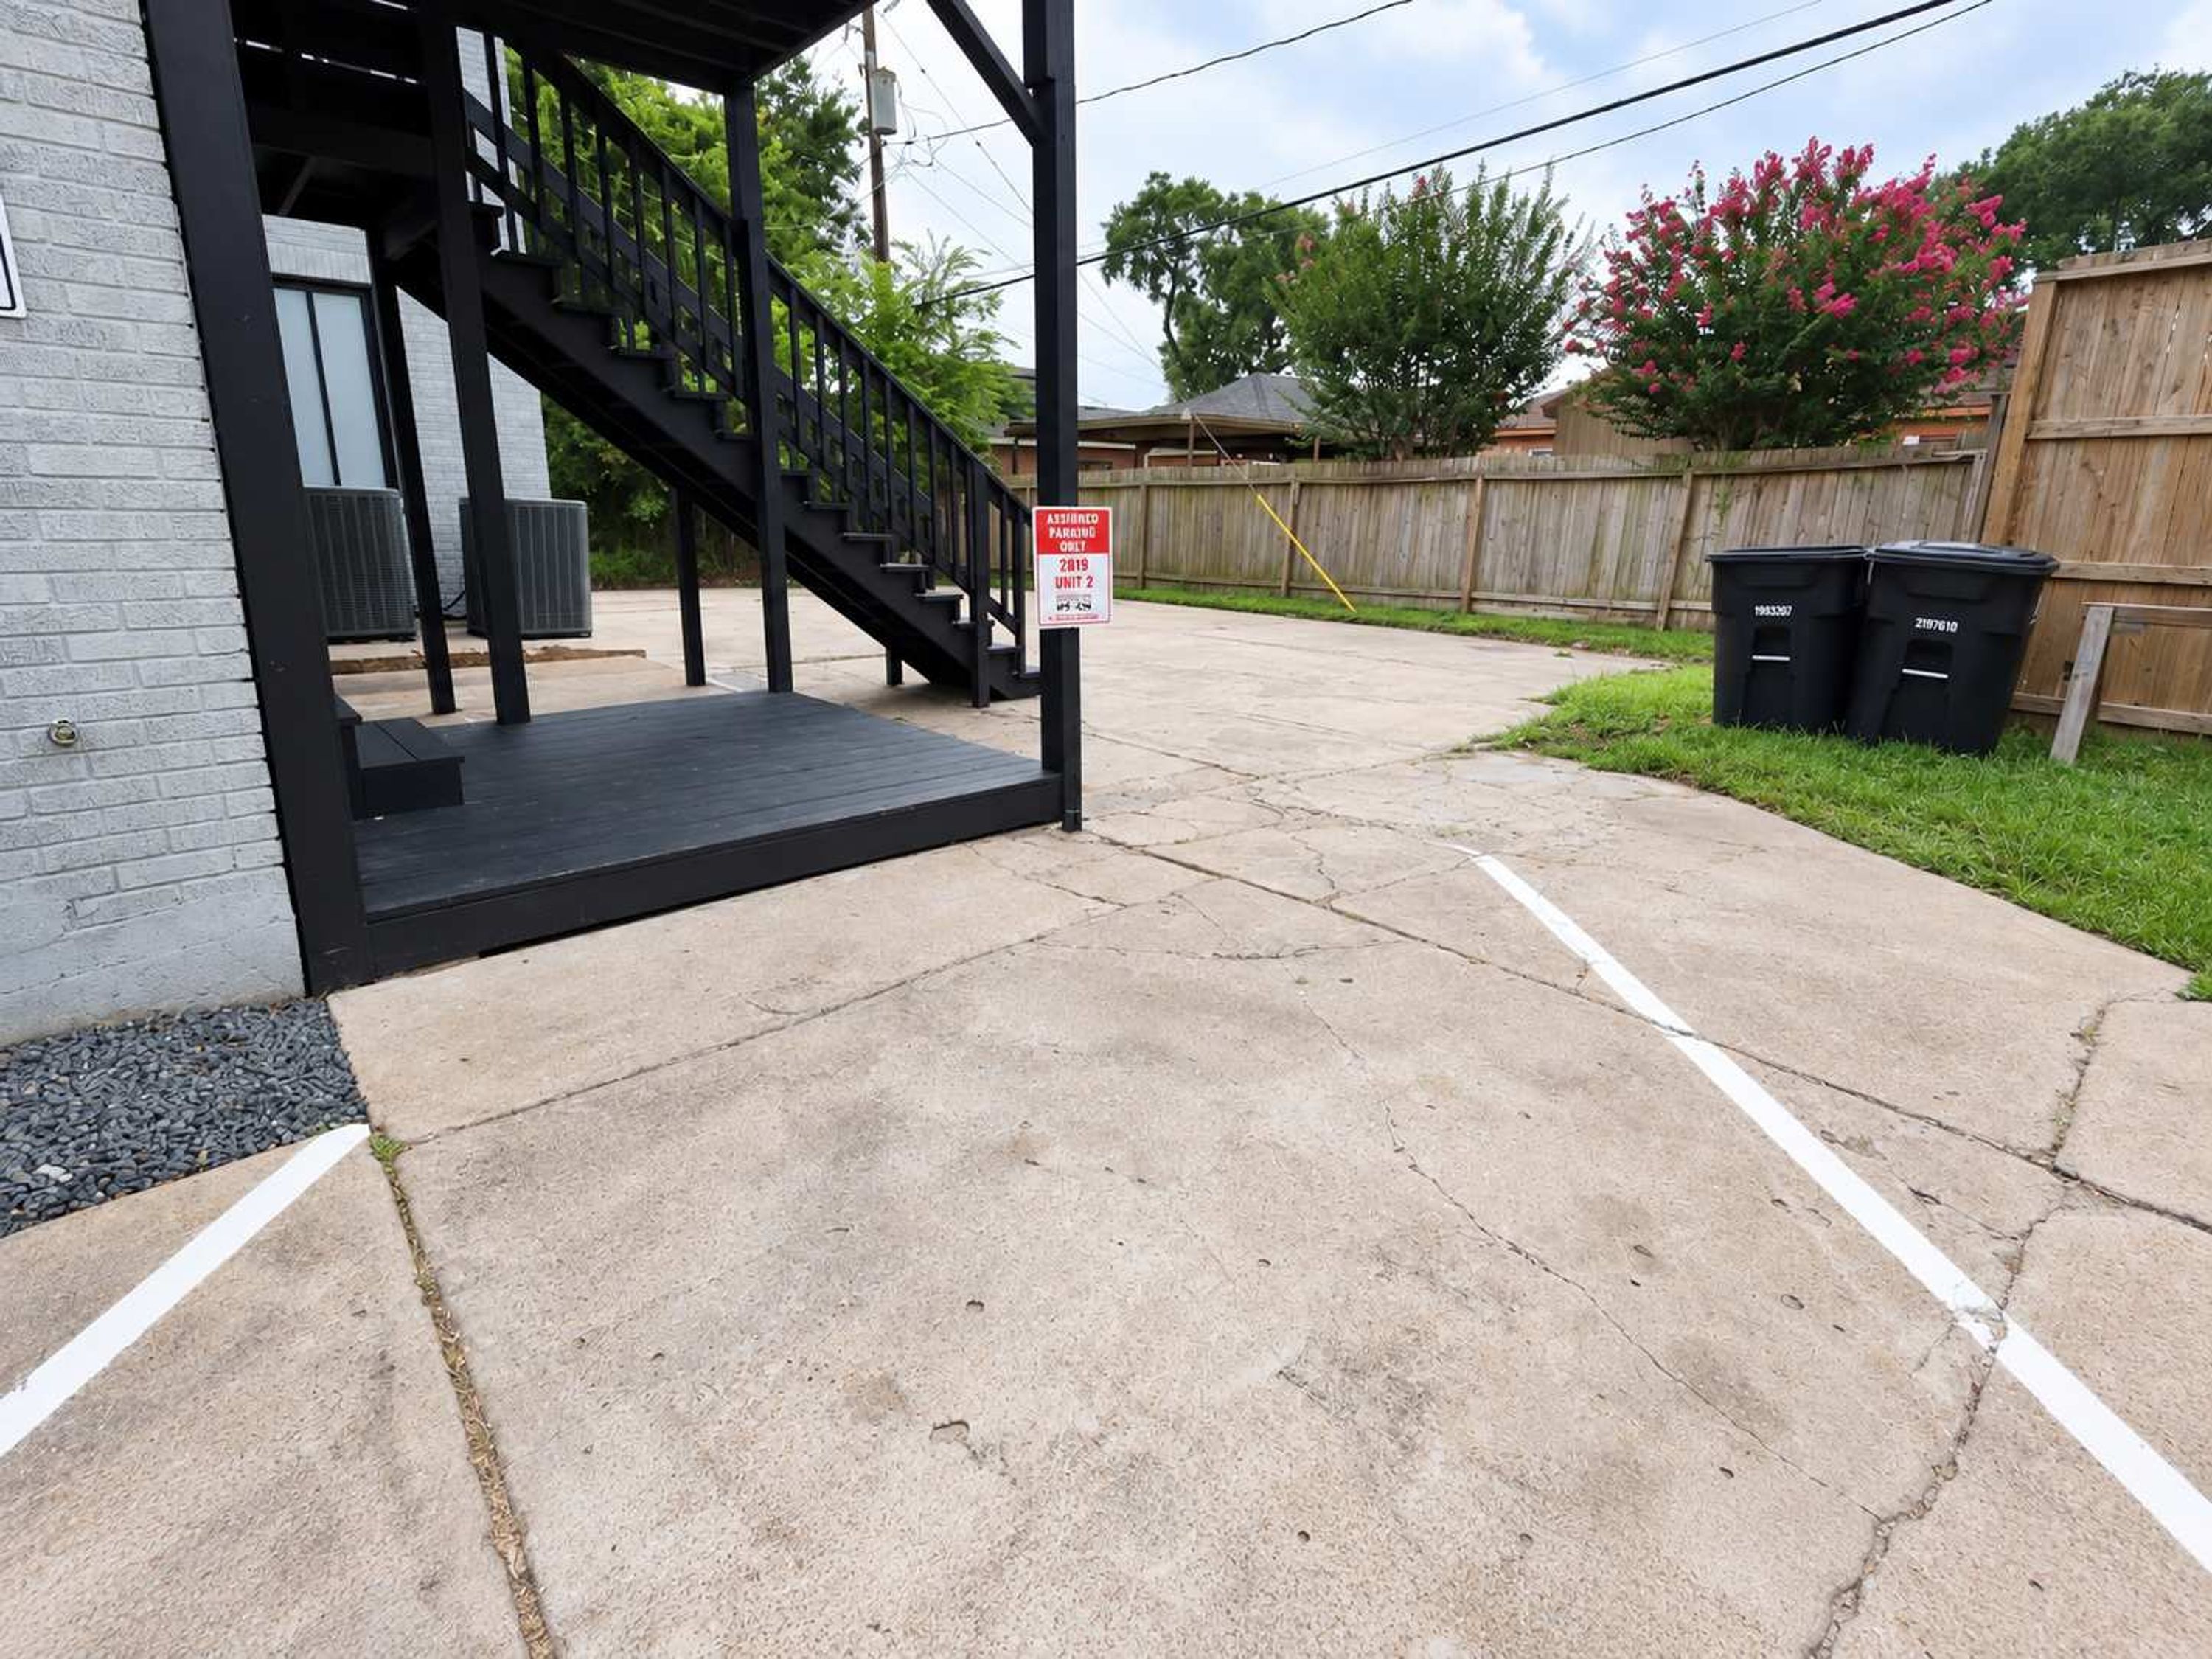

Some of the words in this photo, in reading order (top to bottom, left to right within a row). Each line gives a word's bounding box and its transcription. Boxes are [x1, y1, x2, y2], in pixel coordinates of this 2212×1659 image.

[1049, 526, 1096, 538] PARKING
[1060, 540, 1086, 552] ONLY
[1055, 576, 1082, 588] UNIT
[1086, 575, 1093, 588] 2
